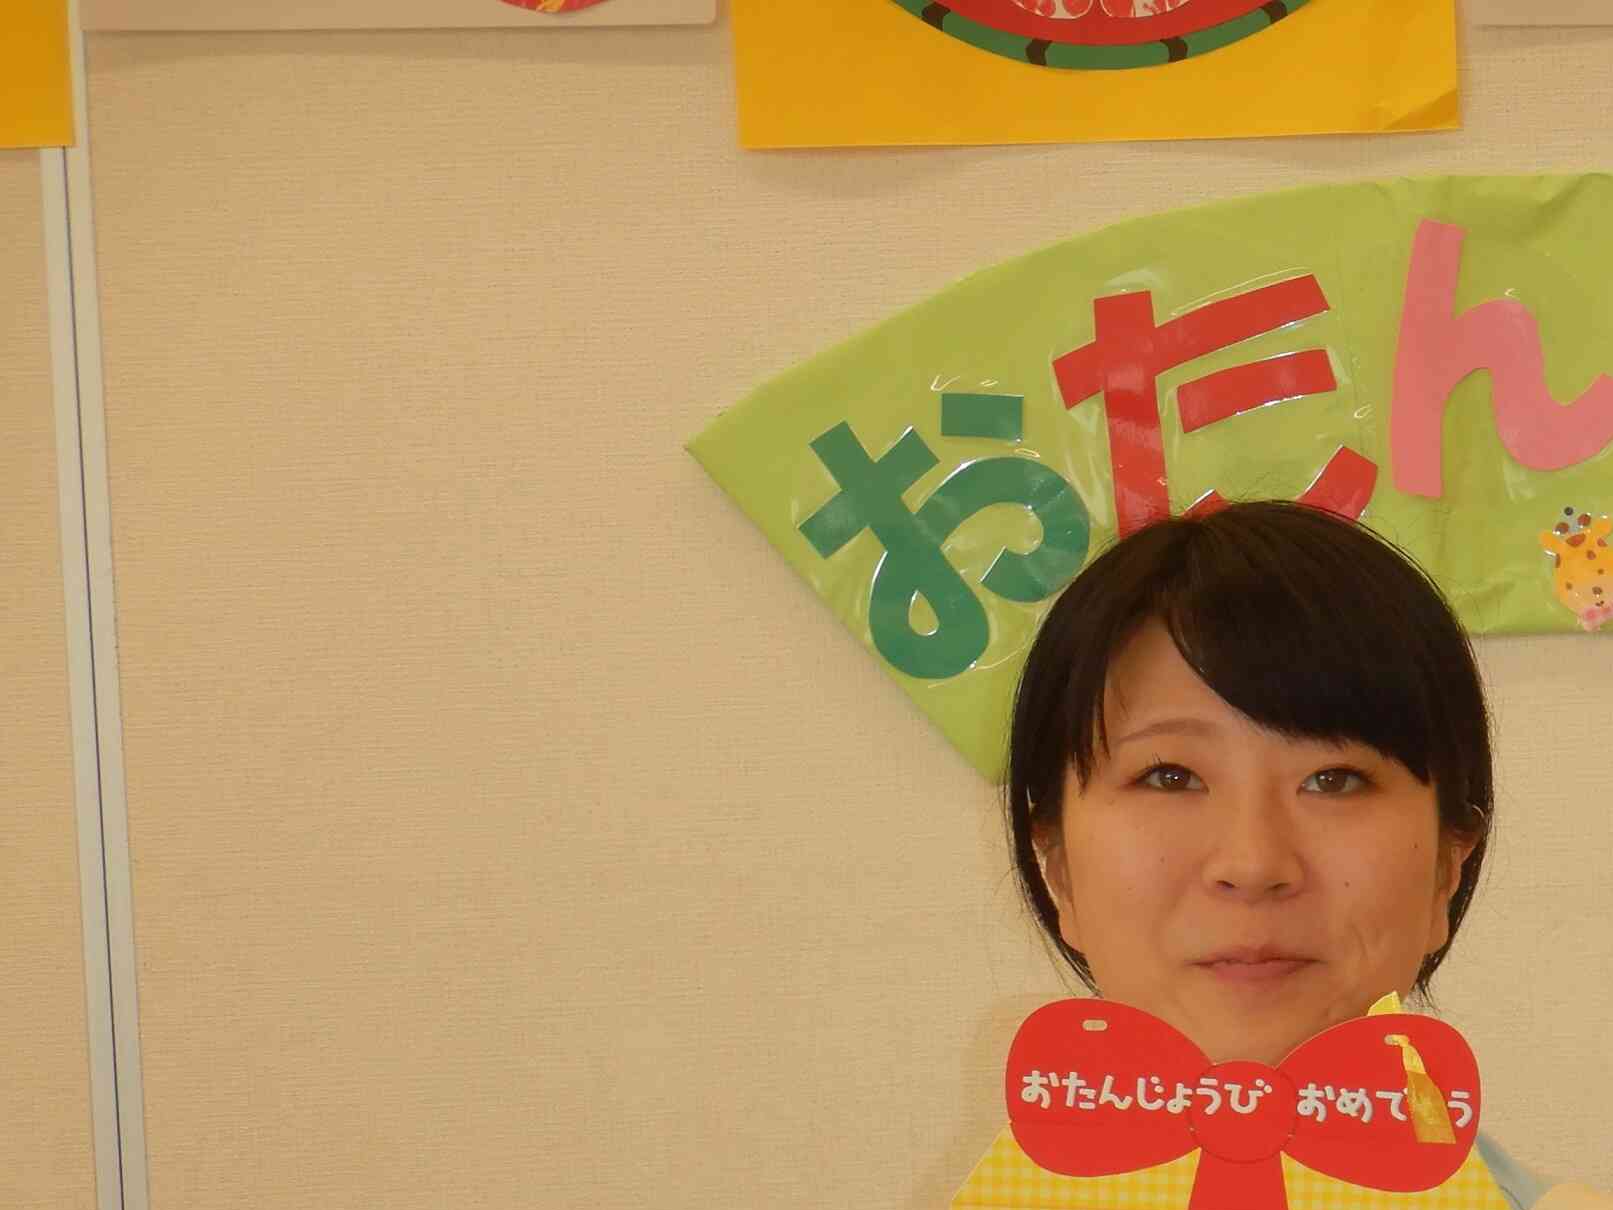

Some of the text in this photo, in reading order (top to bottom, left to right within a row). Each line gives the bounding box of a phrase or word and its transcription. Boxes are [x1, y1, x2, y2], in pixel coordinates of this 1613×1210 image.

[1020, 1069, 1475, 1128] おたんじょうび おめでう
